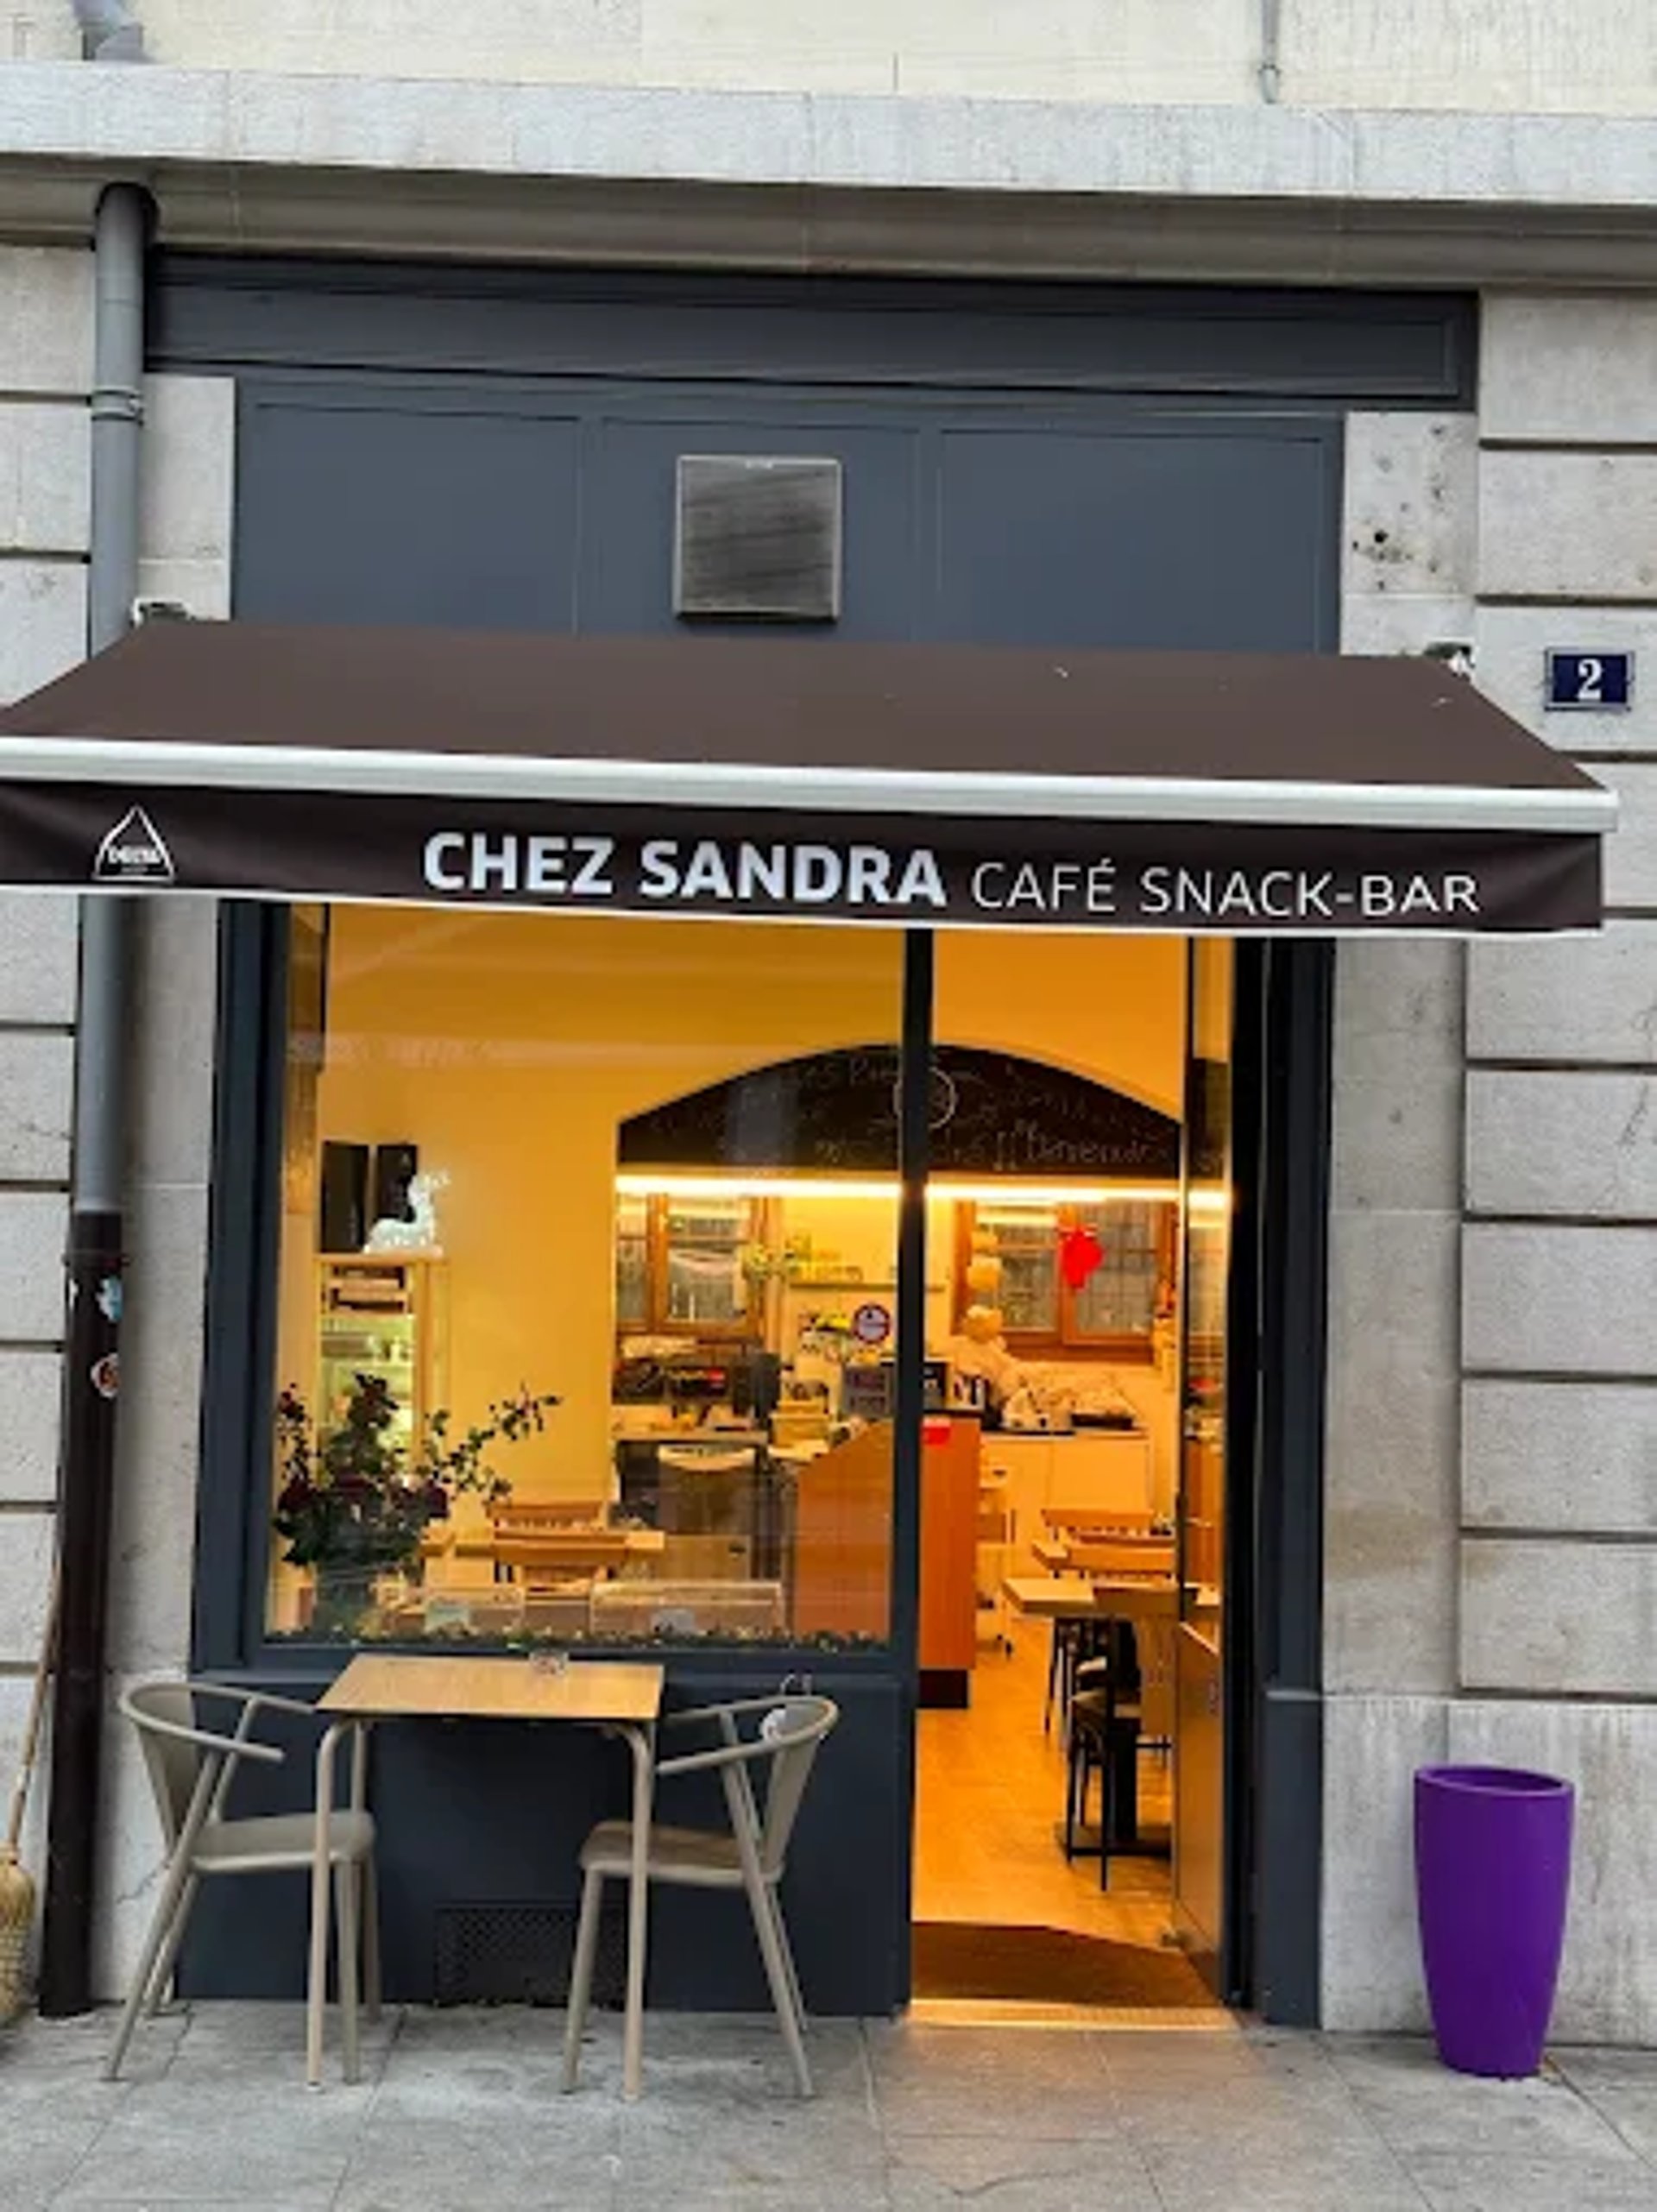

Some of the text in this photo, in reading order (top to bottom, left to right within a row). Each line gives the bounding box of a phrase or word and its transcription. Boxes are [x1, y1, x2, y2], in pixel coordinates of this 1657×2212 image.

[1577, 658, 1603, 700] 2
[424, 832, 1480, 917] CHEZ SANDRA CAFÉ SNACK-BAR
